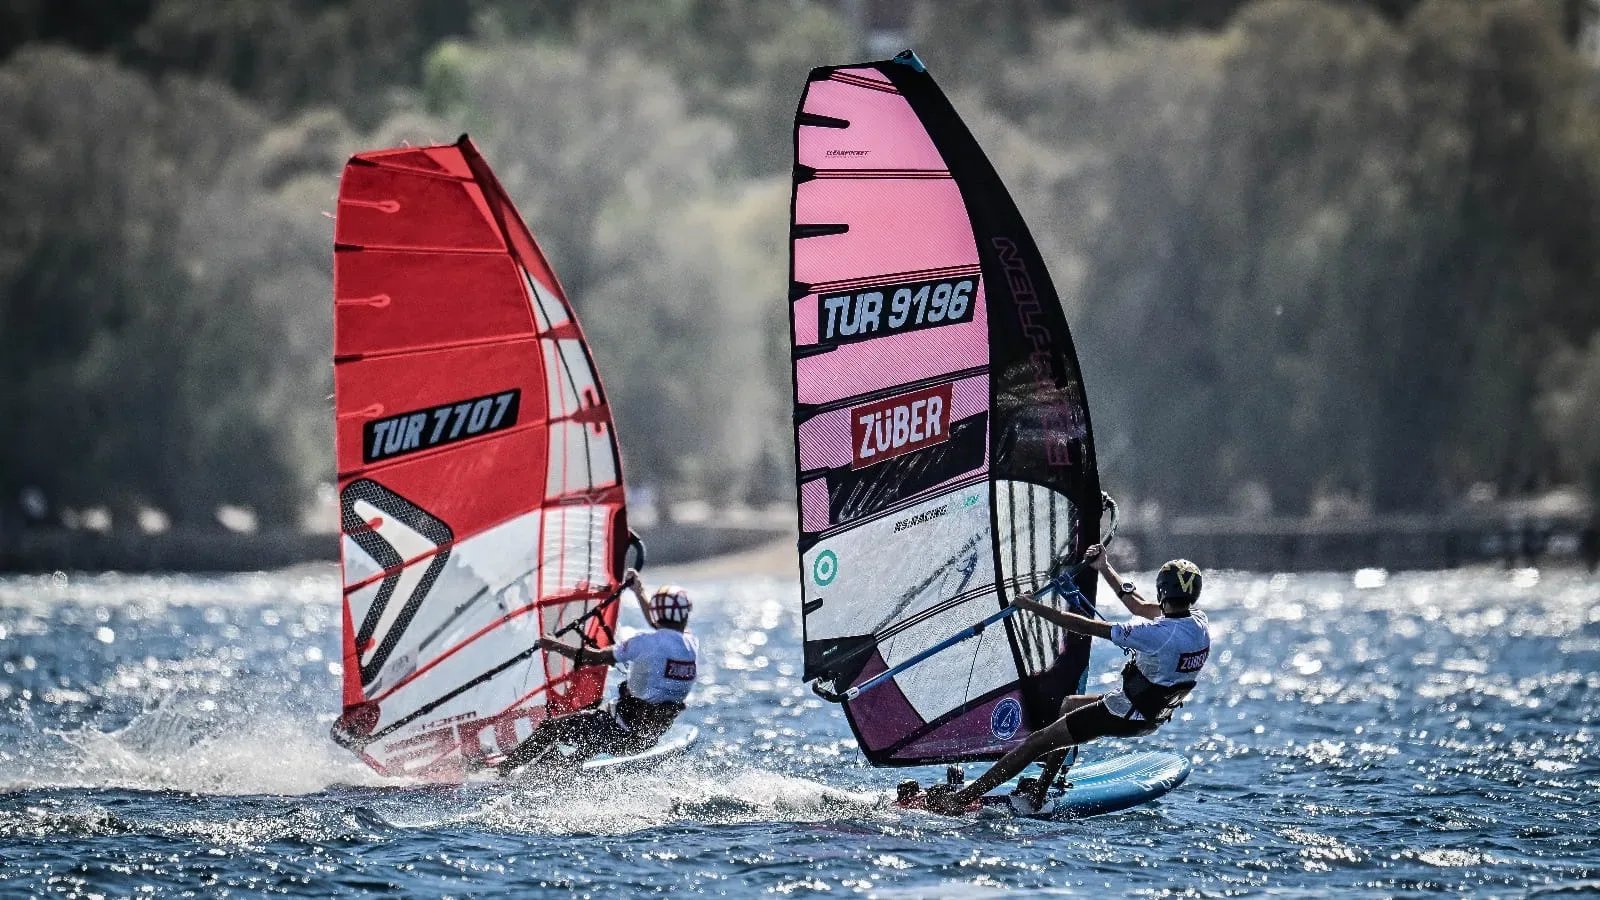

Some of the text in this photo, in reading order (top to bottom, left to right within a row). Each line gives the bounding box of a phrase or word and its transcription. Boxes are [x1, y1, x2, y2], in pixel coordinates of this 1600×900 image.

[824, 280, 973, 339] TUR 9196
[371, 393, 514, 458] TUR 7707
[859, 396, 943, 459] ZÜBER
